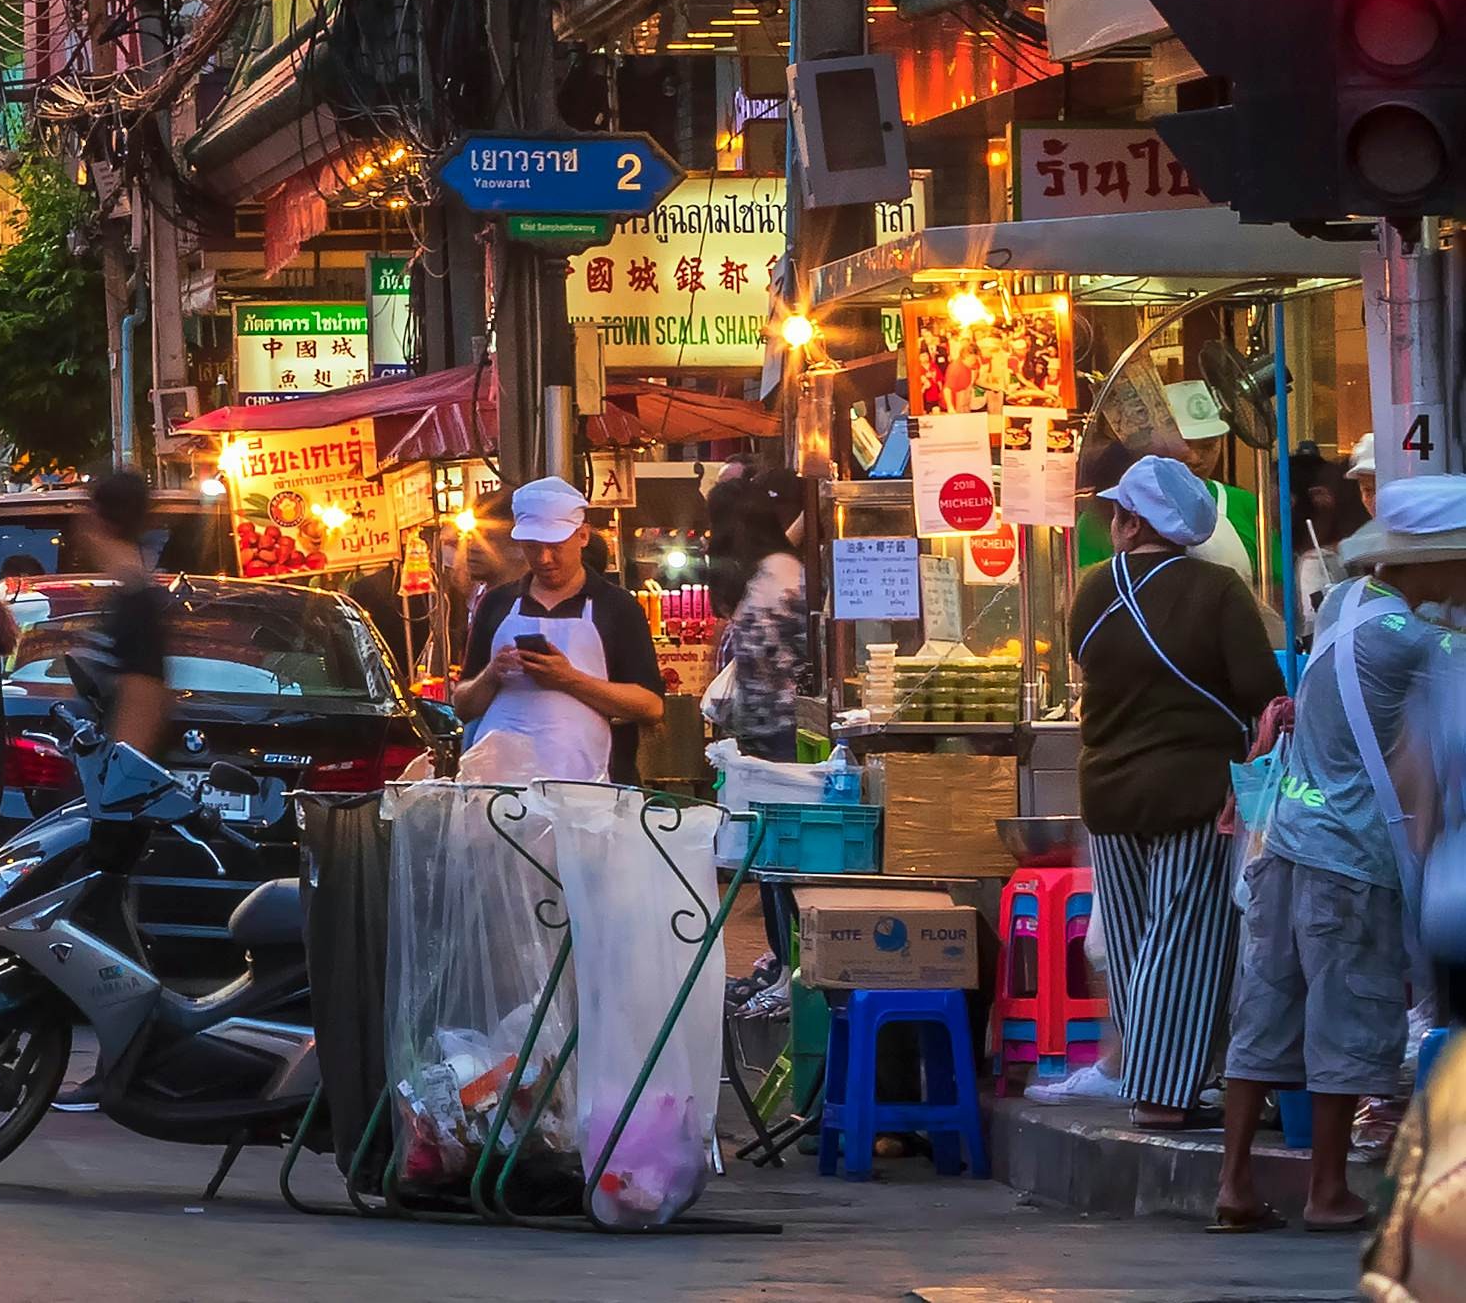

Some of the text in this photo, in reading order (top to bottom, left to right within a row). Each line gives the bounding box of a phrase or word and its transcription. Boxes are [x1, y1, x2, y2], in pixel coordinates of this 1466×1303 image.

[470, 145, 580, 176] เยาวราช
[616, 152, 644, 192] 2
[472, 177, 532, 192] Yaowarat
[570, 255, 777, 294] 國城銀都
[311, 311, 368, 333] ไชน่าทา
[655, 316, 709, 344] SCALA
[262, 337, 357, 360] 中國城
[1401, 413, 1435, 461] 4
[953, 480, 975, 490] 2018
[940, 496, 993, 510] MICHELIN
[971, 538, 1016, 550] MICHELIN
[831, 928, 968, 942] KITE FLOUR
